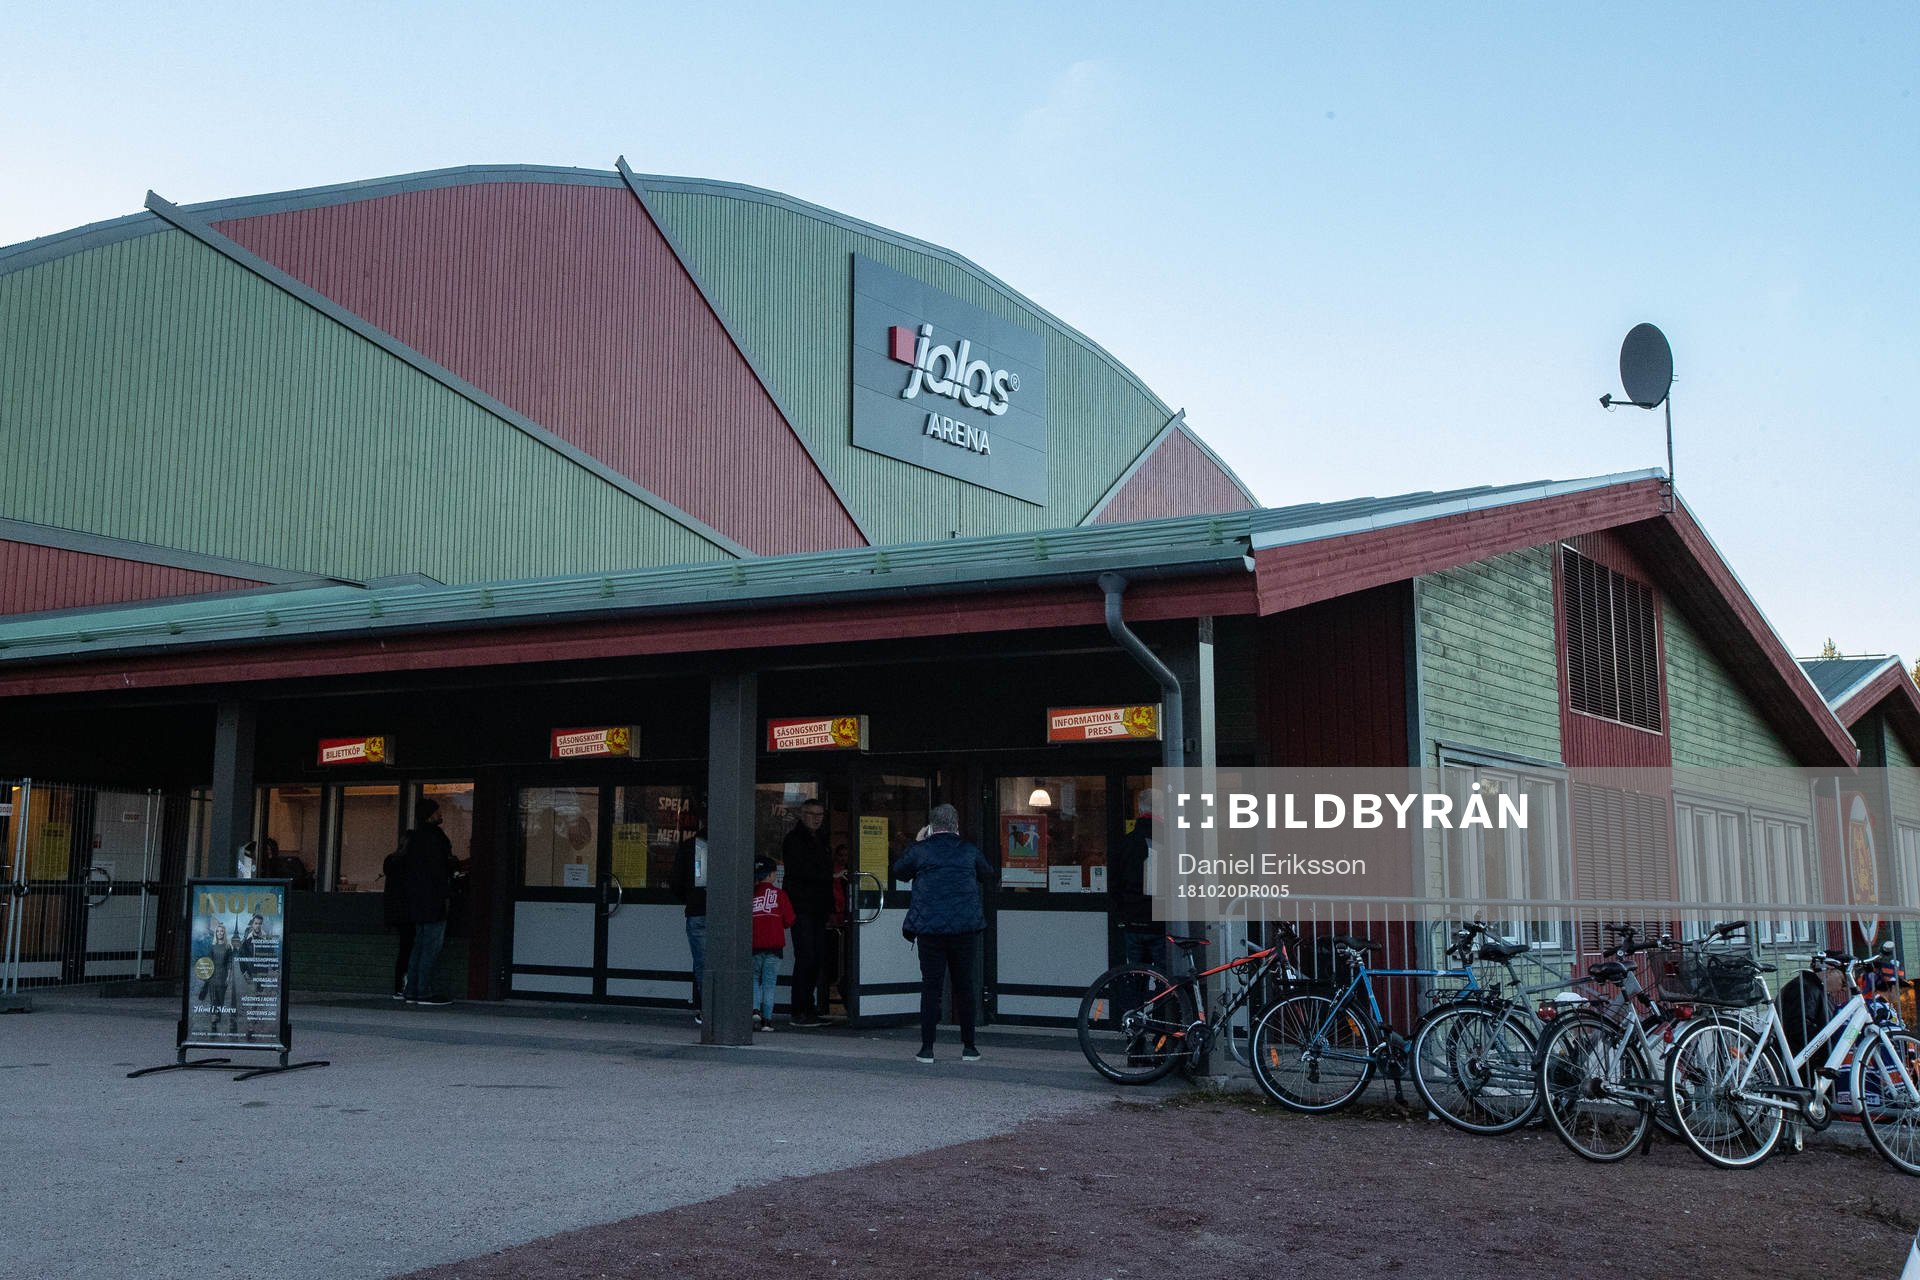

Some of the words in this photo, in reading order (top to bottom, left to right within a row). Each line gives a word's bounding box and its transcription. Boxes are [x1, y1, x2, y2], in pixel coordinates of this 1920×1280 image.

[926, 413, 991, 455] ARENA
[1055, 713, 1111, 728] INFORMATION
[777, 724, 827, 737] SÄSONGSKORT
[1088, 726, 1113, 736] PRESS
[780, 739, 794, 748] OCH
[795, 735, 829, 746] BILJETTER
[326, 746, 361, 759] BILJETTKÖP
[561, 748, 574, 756] OCH
[575, 744, 605, 754] BILJETTER
[658, 796, 690, 812] SPELA
